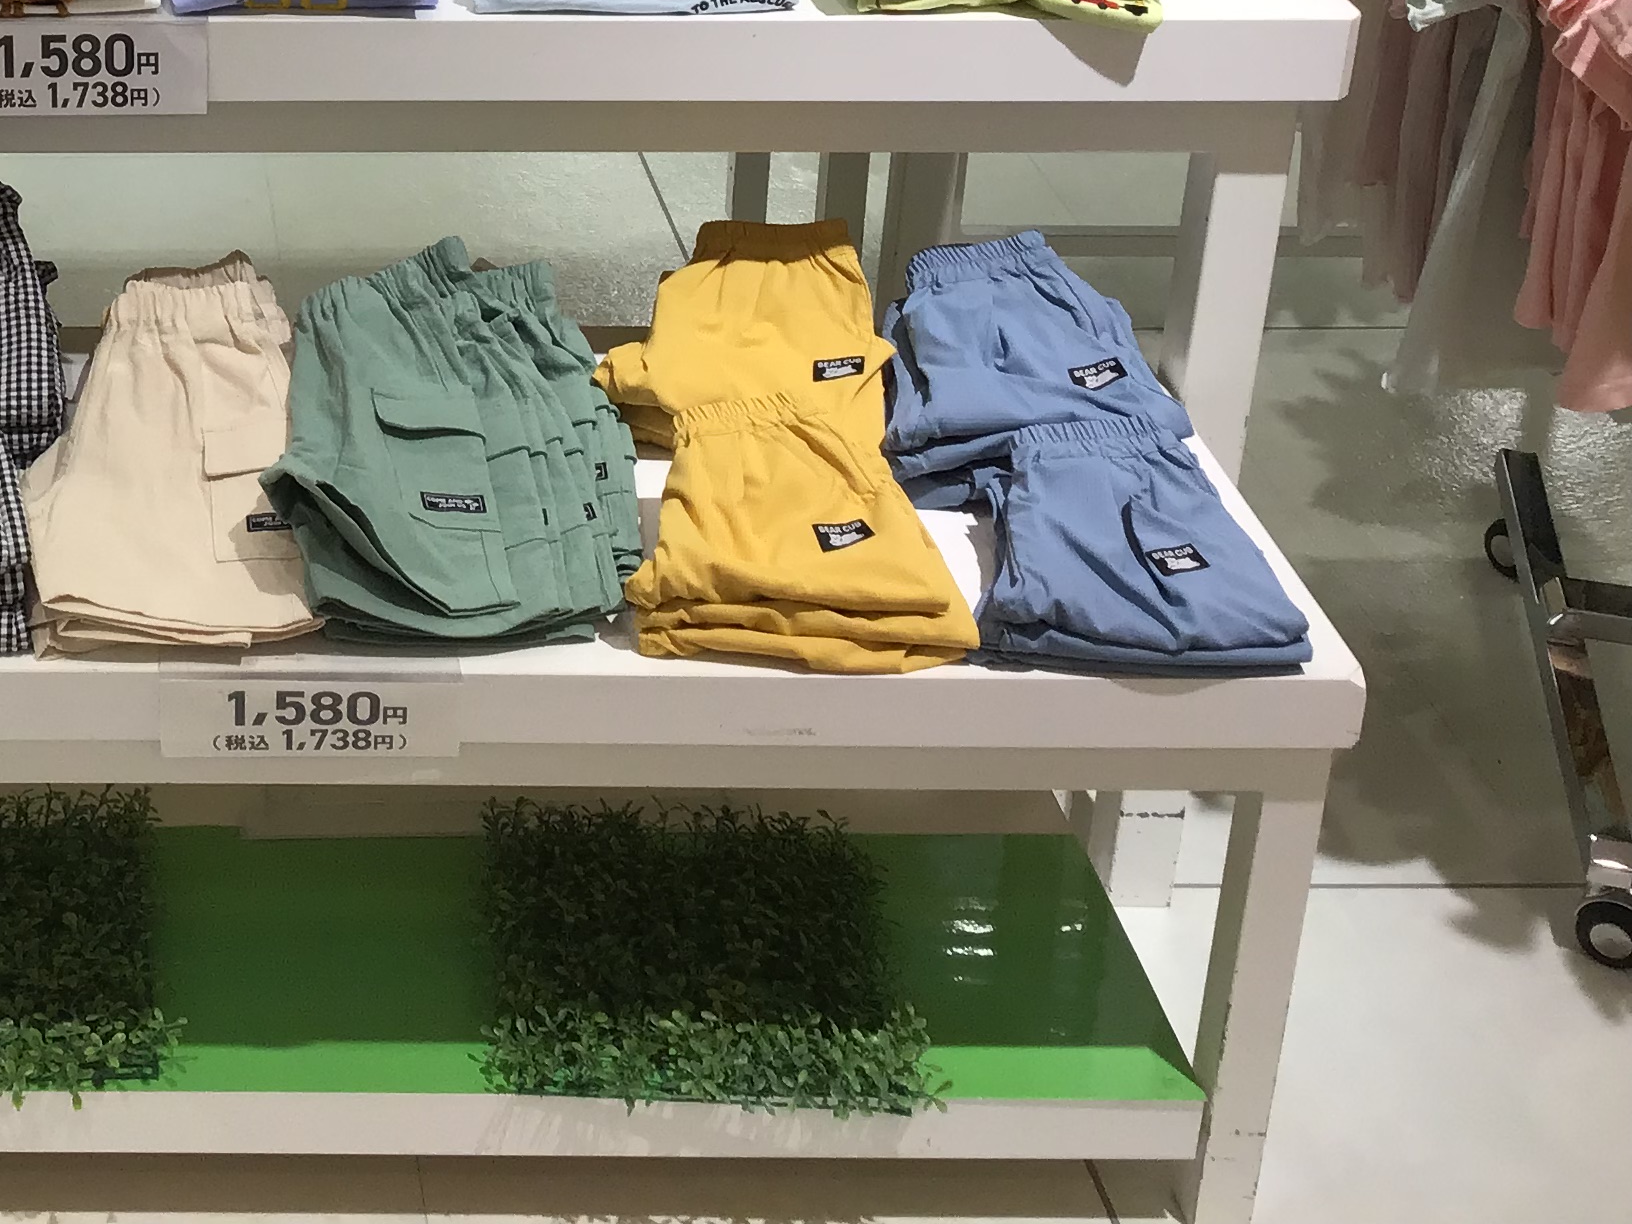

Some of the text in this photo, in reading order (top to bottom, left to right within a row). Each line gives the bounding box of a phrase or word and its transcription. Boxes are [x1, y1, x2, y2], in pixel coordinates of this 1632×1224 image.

[691, 1, 710, 14] TO
[818, 357, 862, 368] BEAR CUB
[1073, 360, 1116, 378] BEAR CUB
[818, 521, 862, 534] BEAR CUB
[1151, 546, 1194, 560] BEAR CUB
[227, 690, 408, 726] 1,580円
